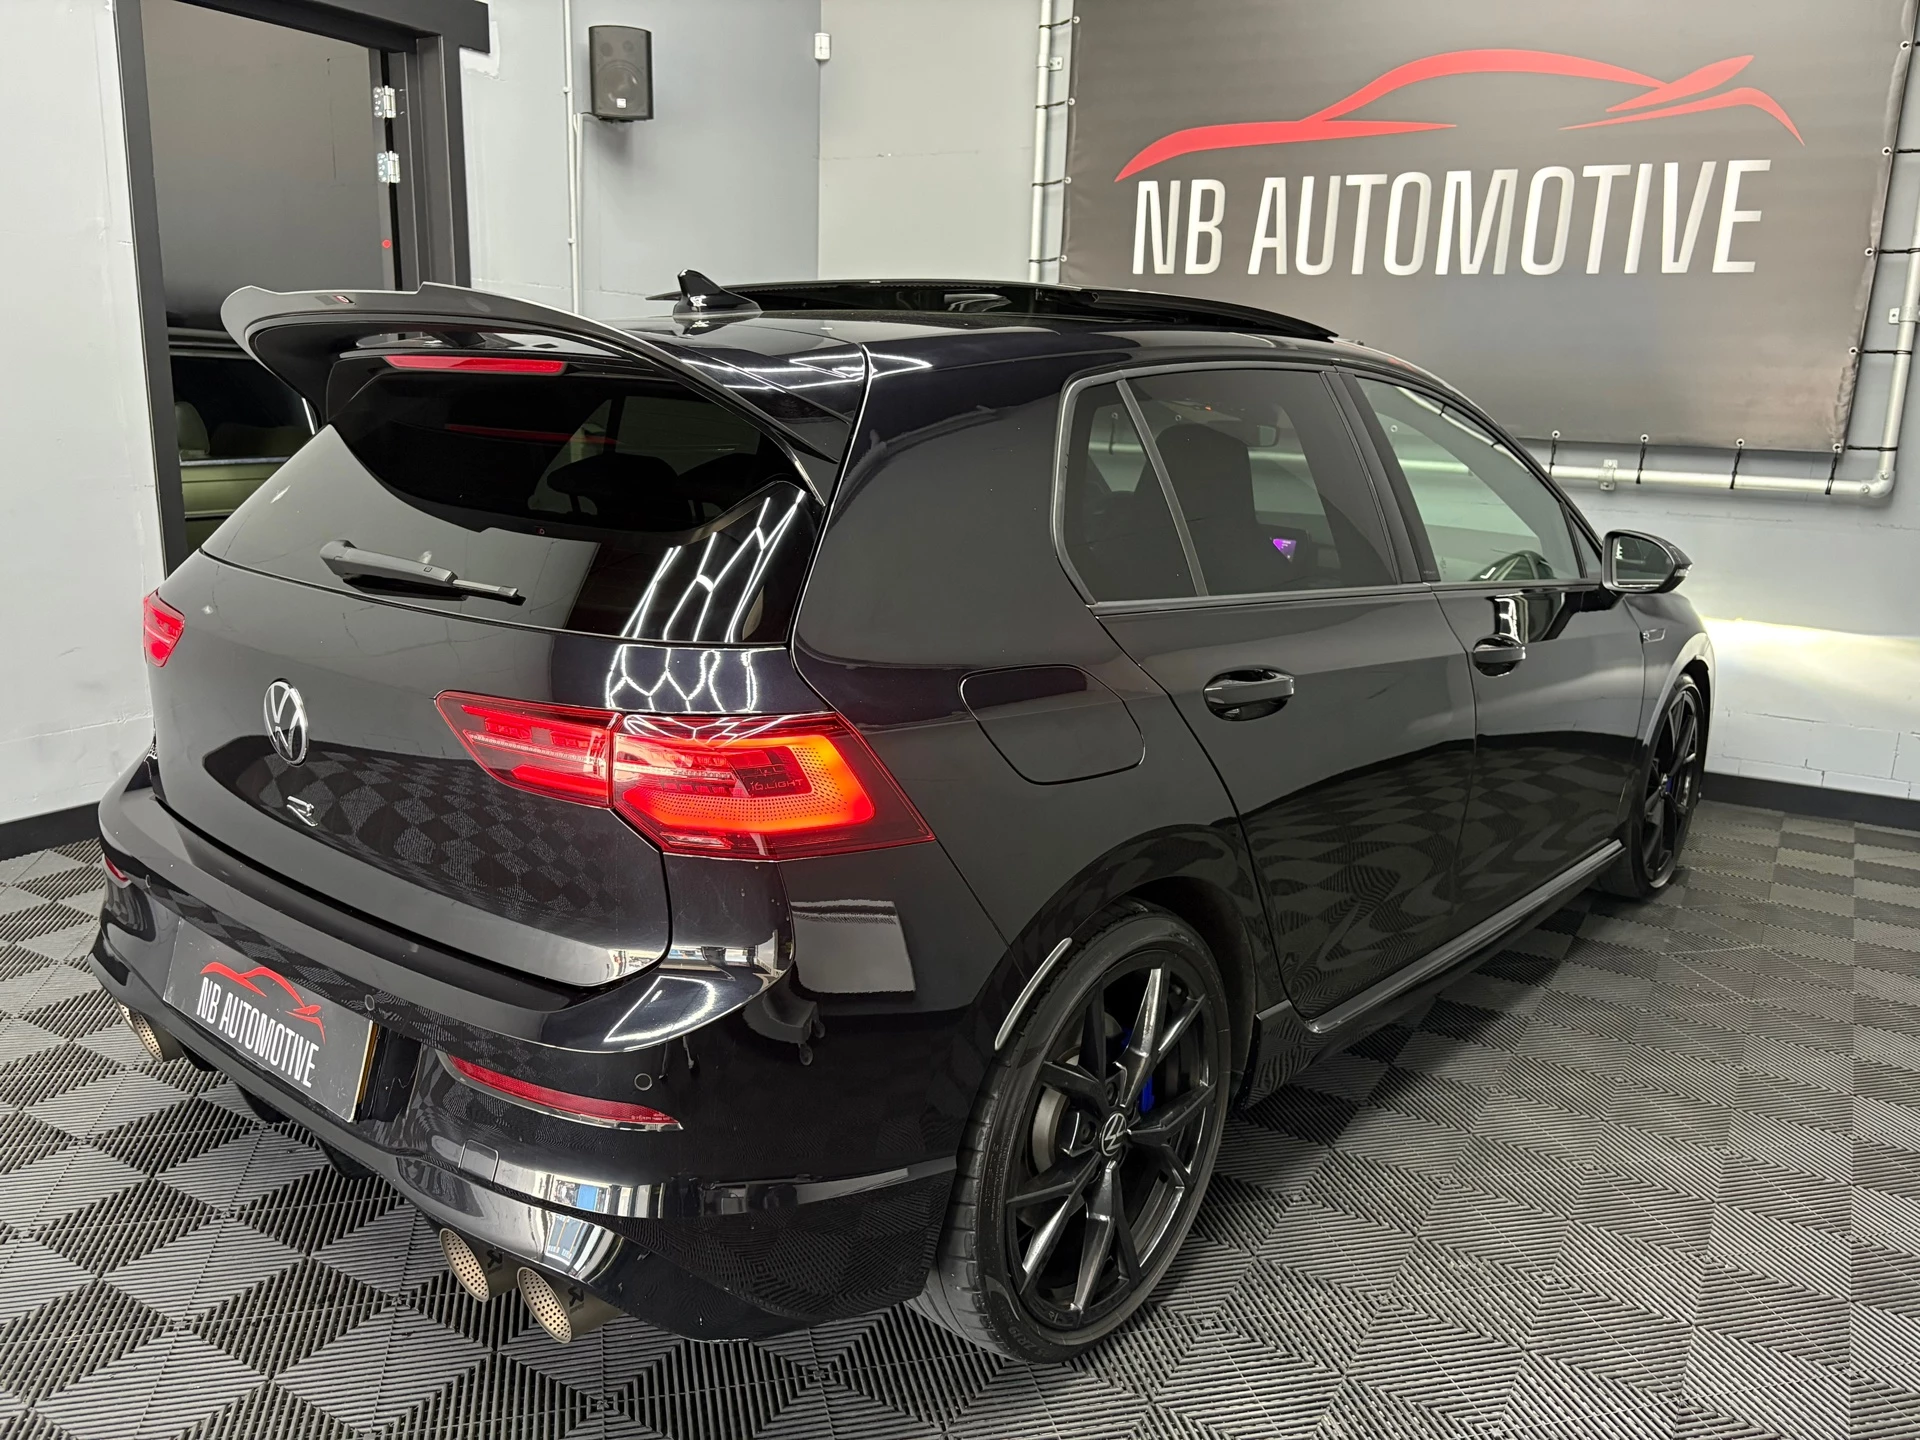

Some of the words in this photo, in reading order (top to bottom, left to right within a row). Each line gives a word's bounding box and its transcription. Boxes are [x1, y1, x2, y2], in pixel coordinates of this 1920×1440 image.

[1132, 180, 1226, 275] NB
[1247, 159, 1772, 276] AUTOMOTIVE
[196, 976, 222, 1025] NB
[218, 991, 320, 1089] AUTOMOTIVE
